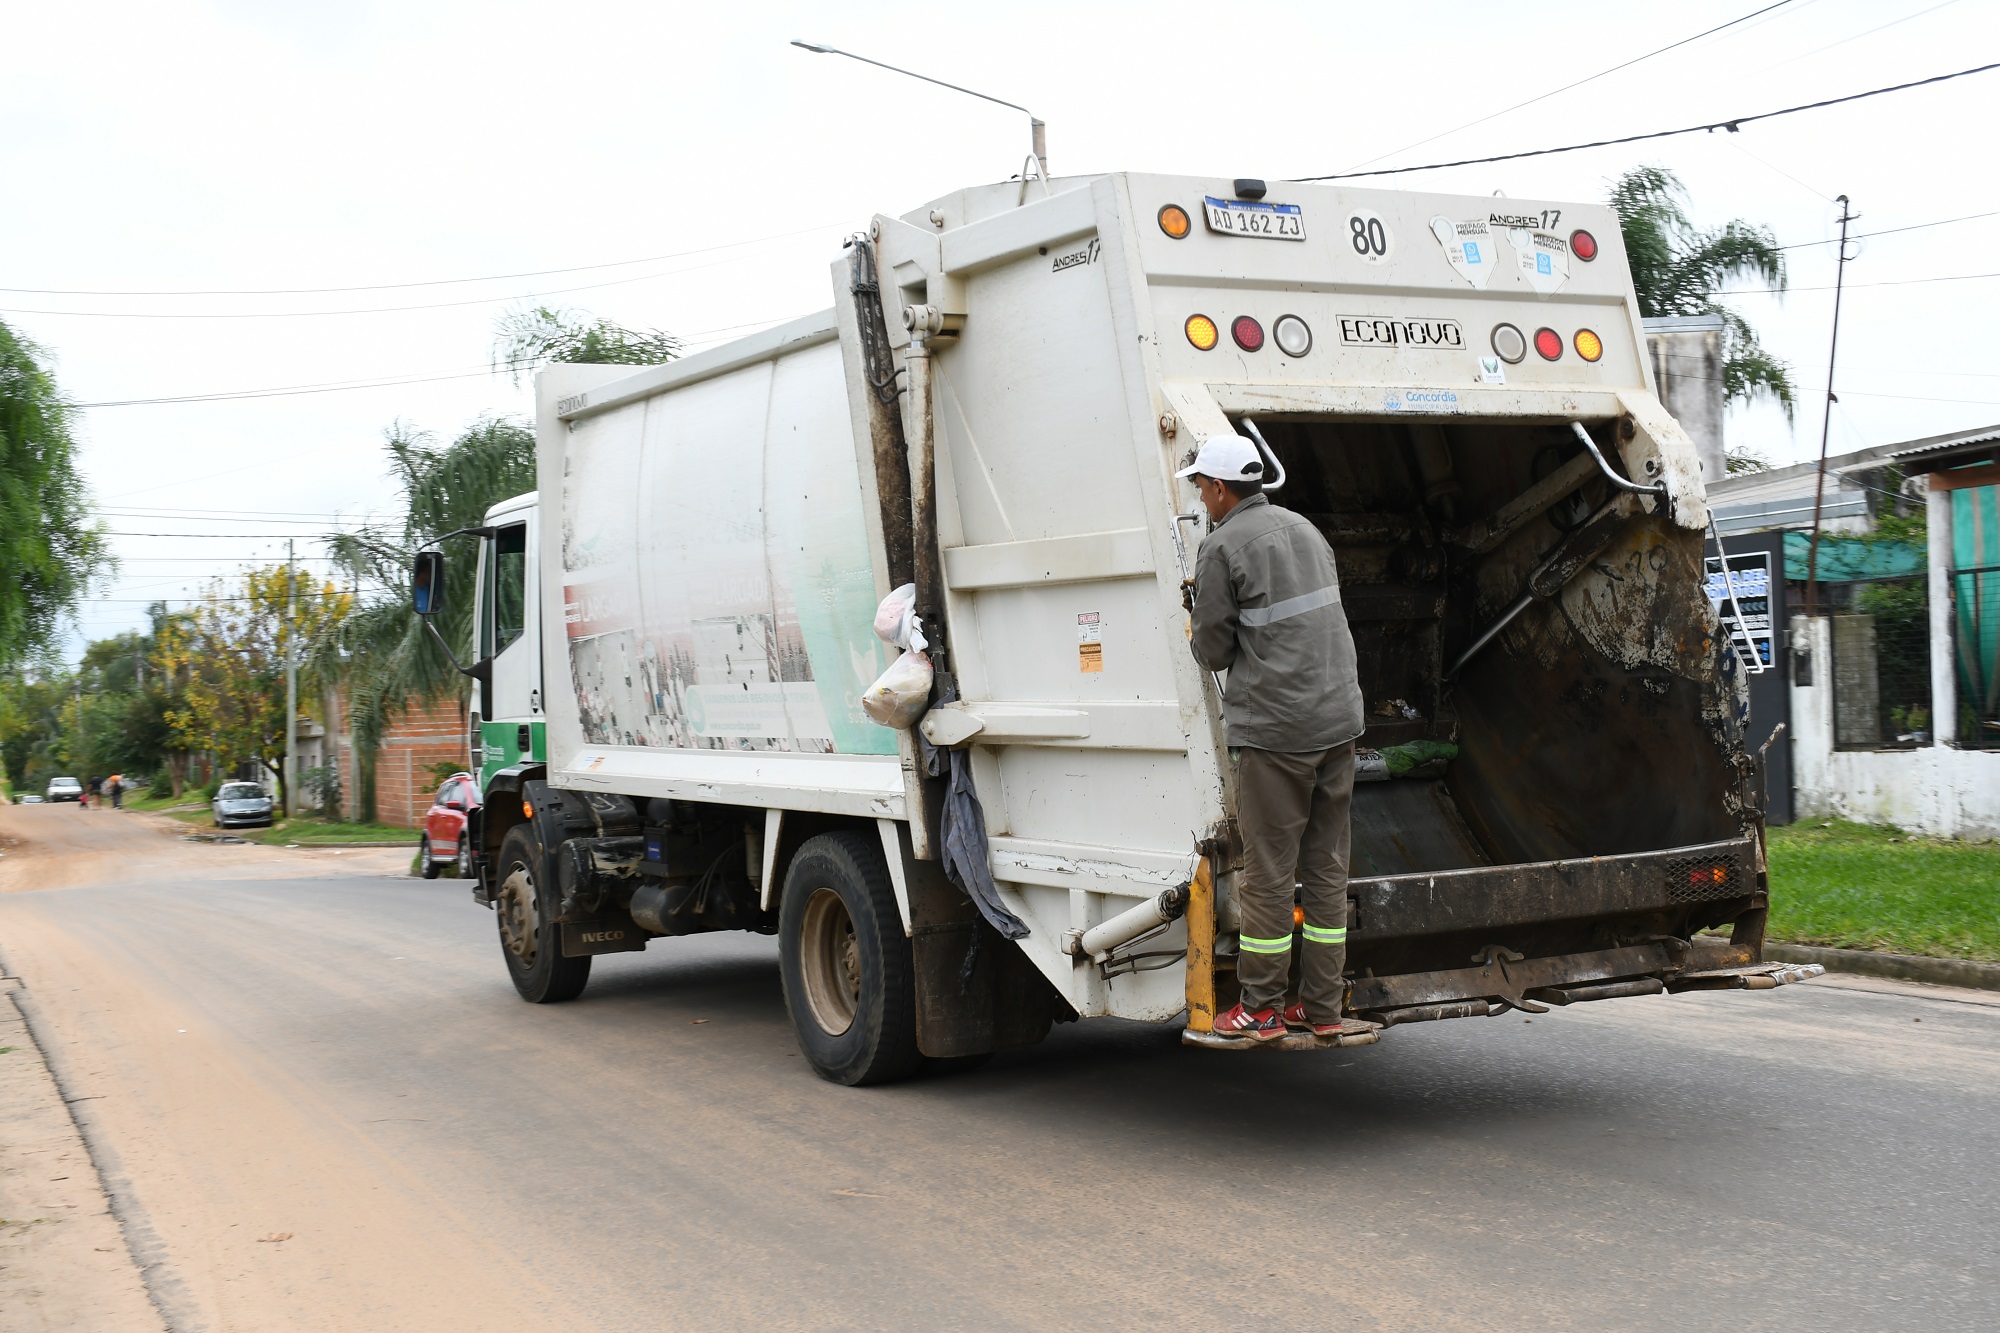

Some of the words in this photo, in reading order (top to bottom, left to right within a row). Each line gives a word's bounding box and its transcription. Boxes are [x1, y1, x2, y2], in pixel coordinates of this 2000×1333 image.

[1213, 208, 1233, 229] AD
[1237, 212, 1272, 233] 162
[1276, 215, 1300, 235] ZJ
[1455, 222, 1487, 231] PREPAGO
[1489, 213, 1539, 228] ANDRES
[1540, 209, 1562, 230] 17
[1350, 216, 1387, 256] 80
[1533, 239, 1565, 252] MENSUAL
[1052, 250, 1087, 272] ANDRES
[1086, 237, 1101, 265] 17
[1341, 319, 1461, 345] ECONOVO
[1405, 391, 1457, 402] Concordia
[582, 930, 625, 943] IVECO
